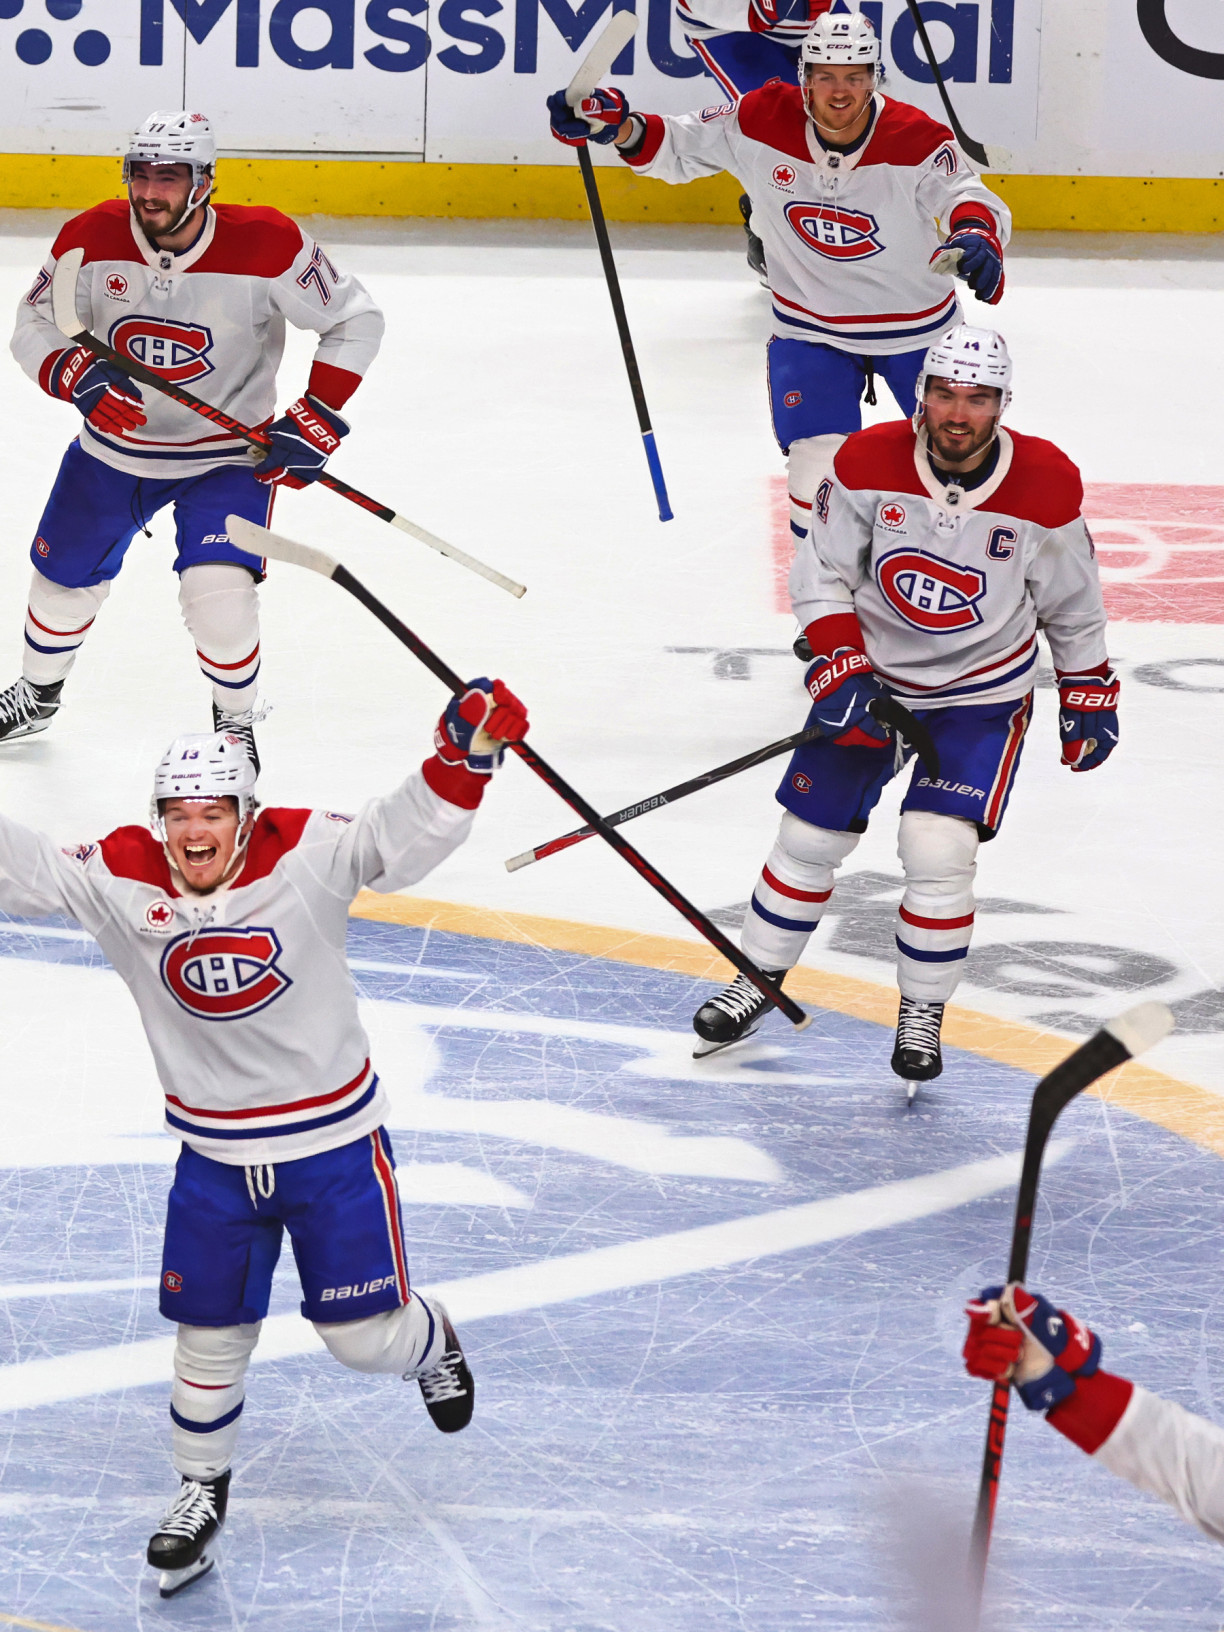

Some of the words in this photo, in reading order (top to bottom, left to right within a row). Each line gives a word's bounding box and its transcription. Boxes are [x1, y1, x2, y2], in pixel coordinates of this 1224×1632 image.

[934, 144, 957, 177] 7
[775, 186, 795, 195] CANADA
[296, 242, 339, 306] 77
[884, 526, 907, 535] CANADA
[985, 525, 1018, 561] C
[320, 1275, 396, 1302] BAUER
